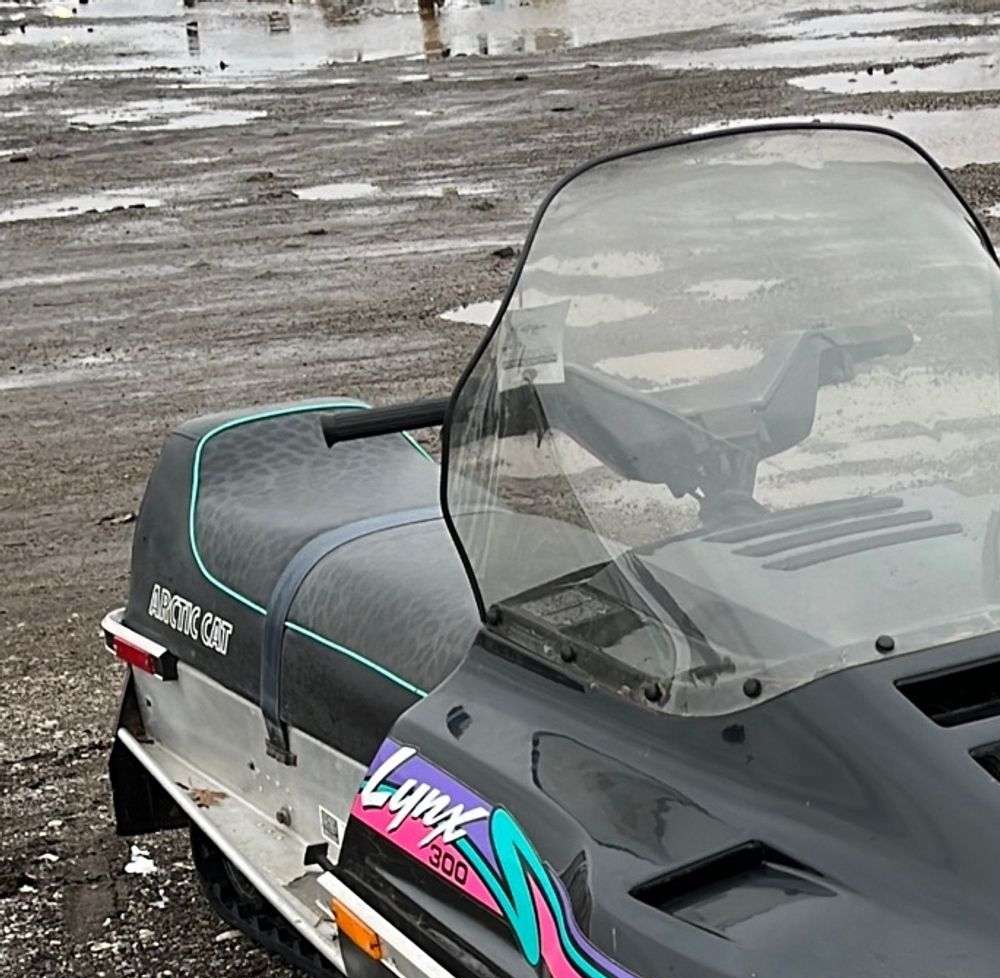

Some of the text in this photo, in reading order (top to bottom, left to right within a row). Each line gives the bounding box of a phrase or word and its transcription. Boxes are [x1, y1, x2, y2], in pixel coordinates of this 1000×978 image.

[149, 583, 234, 656] ARCTIC CAT
[361, 746, 490, 849] Lynx
[428, 844, 469, 886] 300
